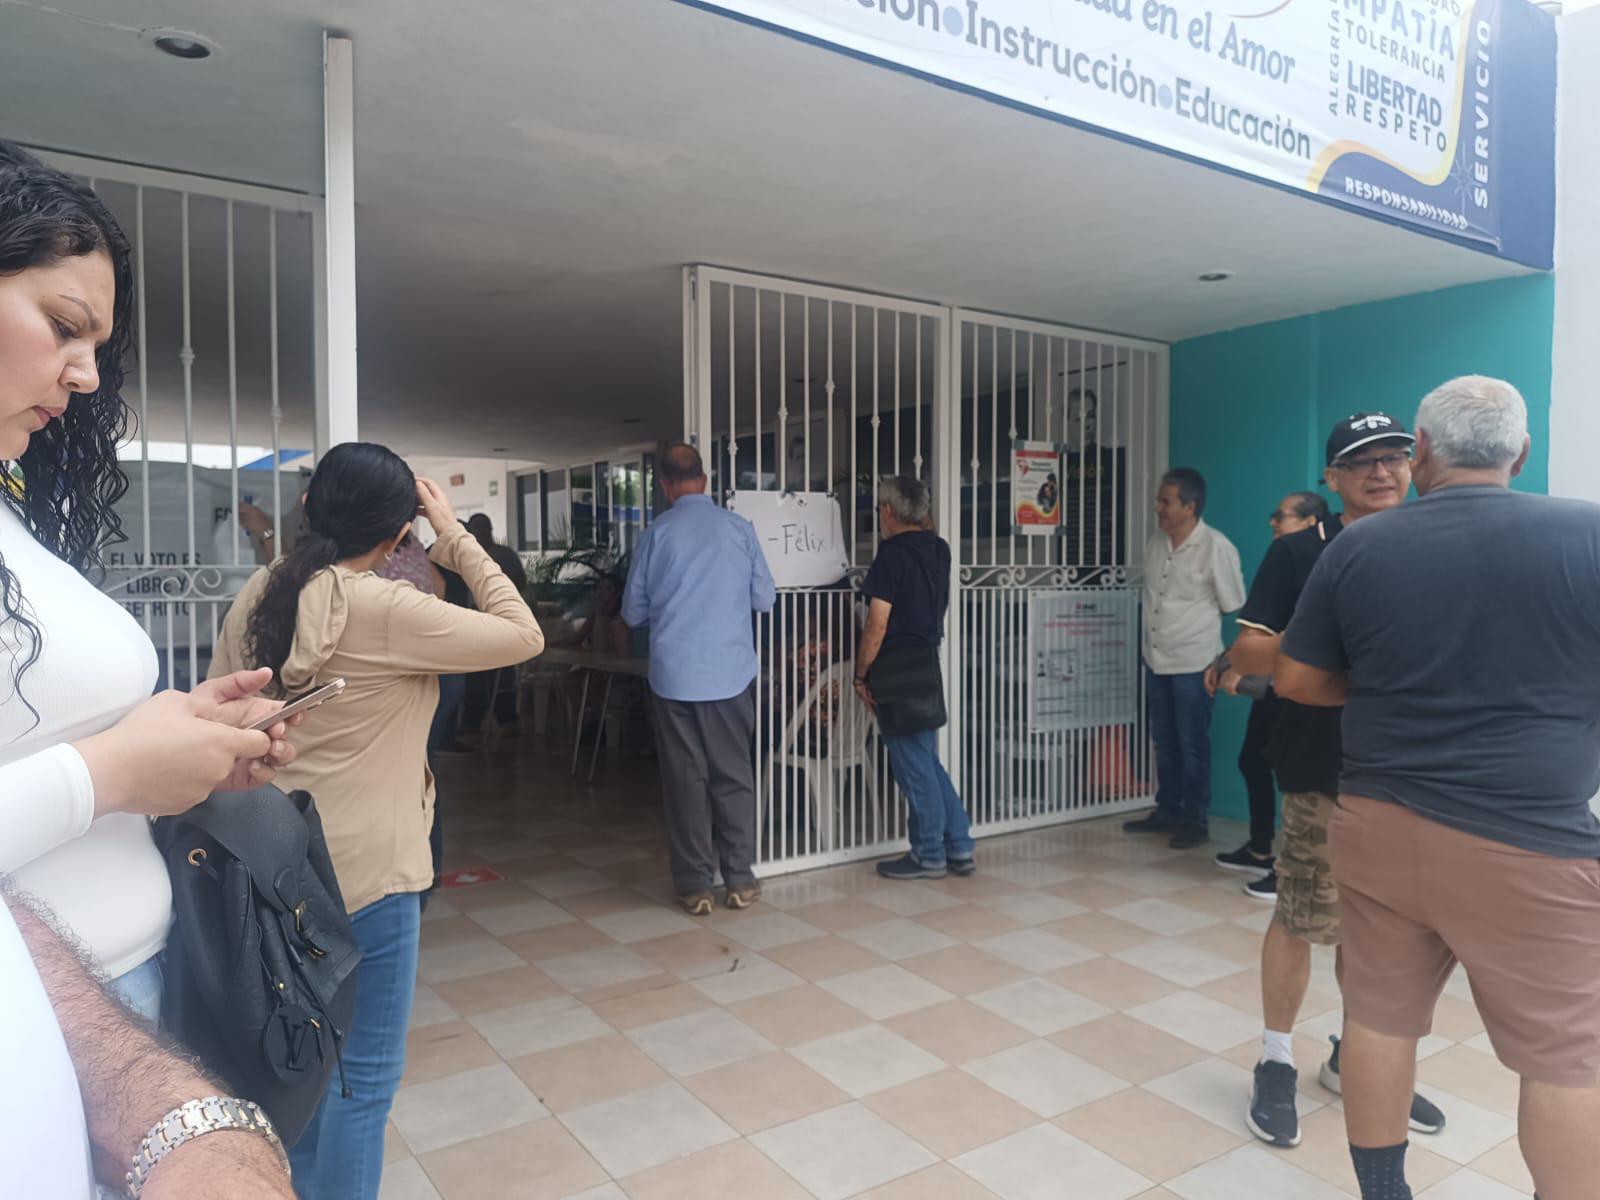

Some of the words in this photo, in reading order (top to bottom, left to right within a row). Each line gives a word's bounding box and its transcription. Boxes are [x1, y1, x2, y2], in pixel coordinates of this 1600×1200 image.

[966, 0, 1157, 107] Instrucción
[1175, 77, 1311, 159] Educación
[1142, 0, 1179, 40] en
[1188, 11, 1211, 53] el
[1218, 21, 1296, 84] Amor
[1328, 10, 1340, 117] ALEGRÍA
[1345, 18, 1446, 84] TOLERANCIA
[1346, 94, 1447, 152] RESPETO
[1347, 60, 1443, 127] LIBERTAD
[1474, 20, 1490, 209] SERVICIO
[1345, 176, 1469, 230] RESPONSABILIDAD
